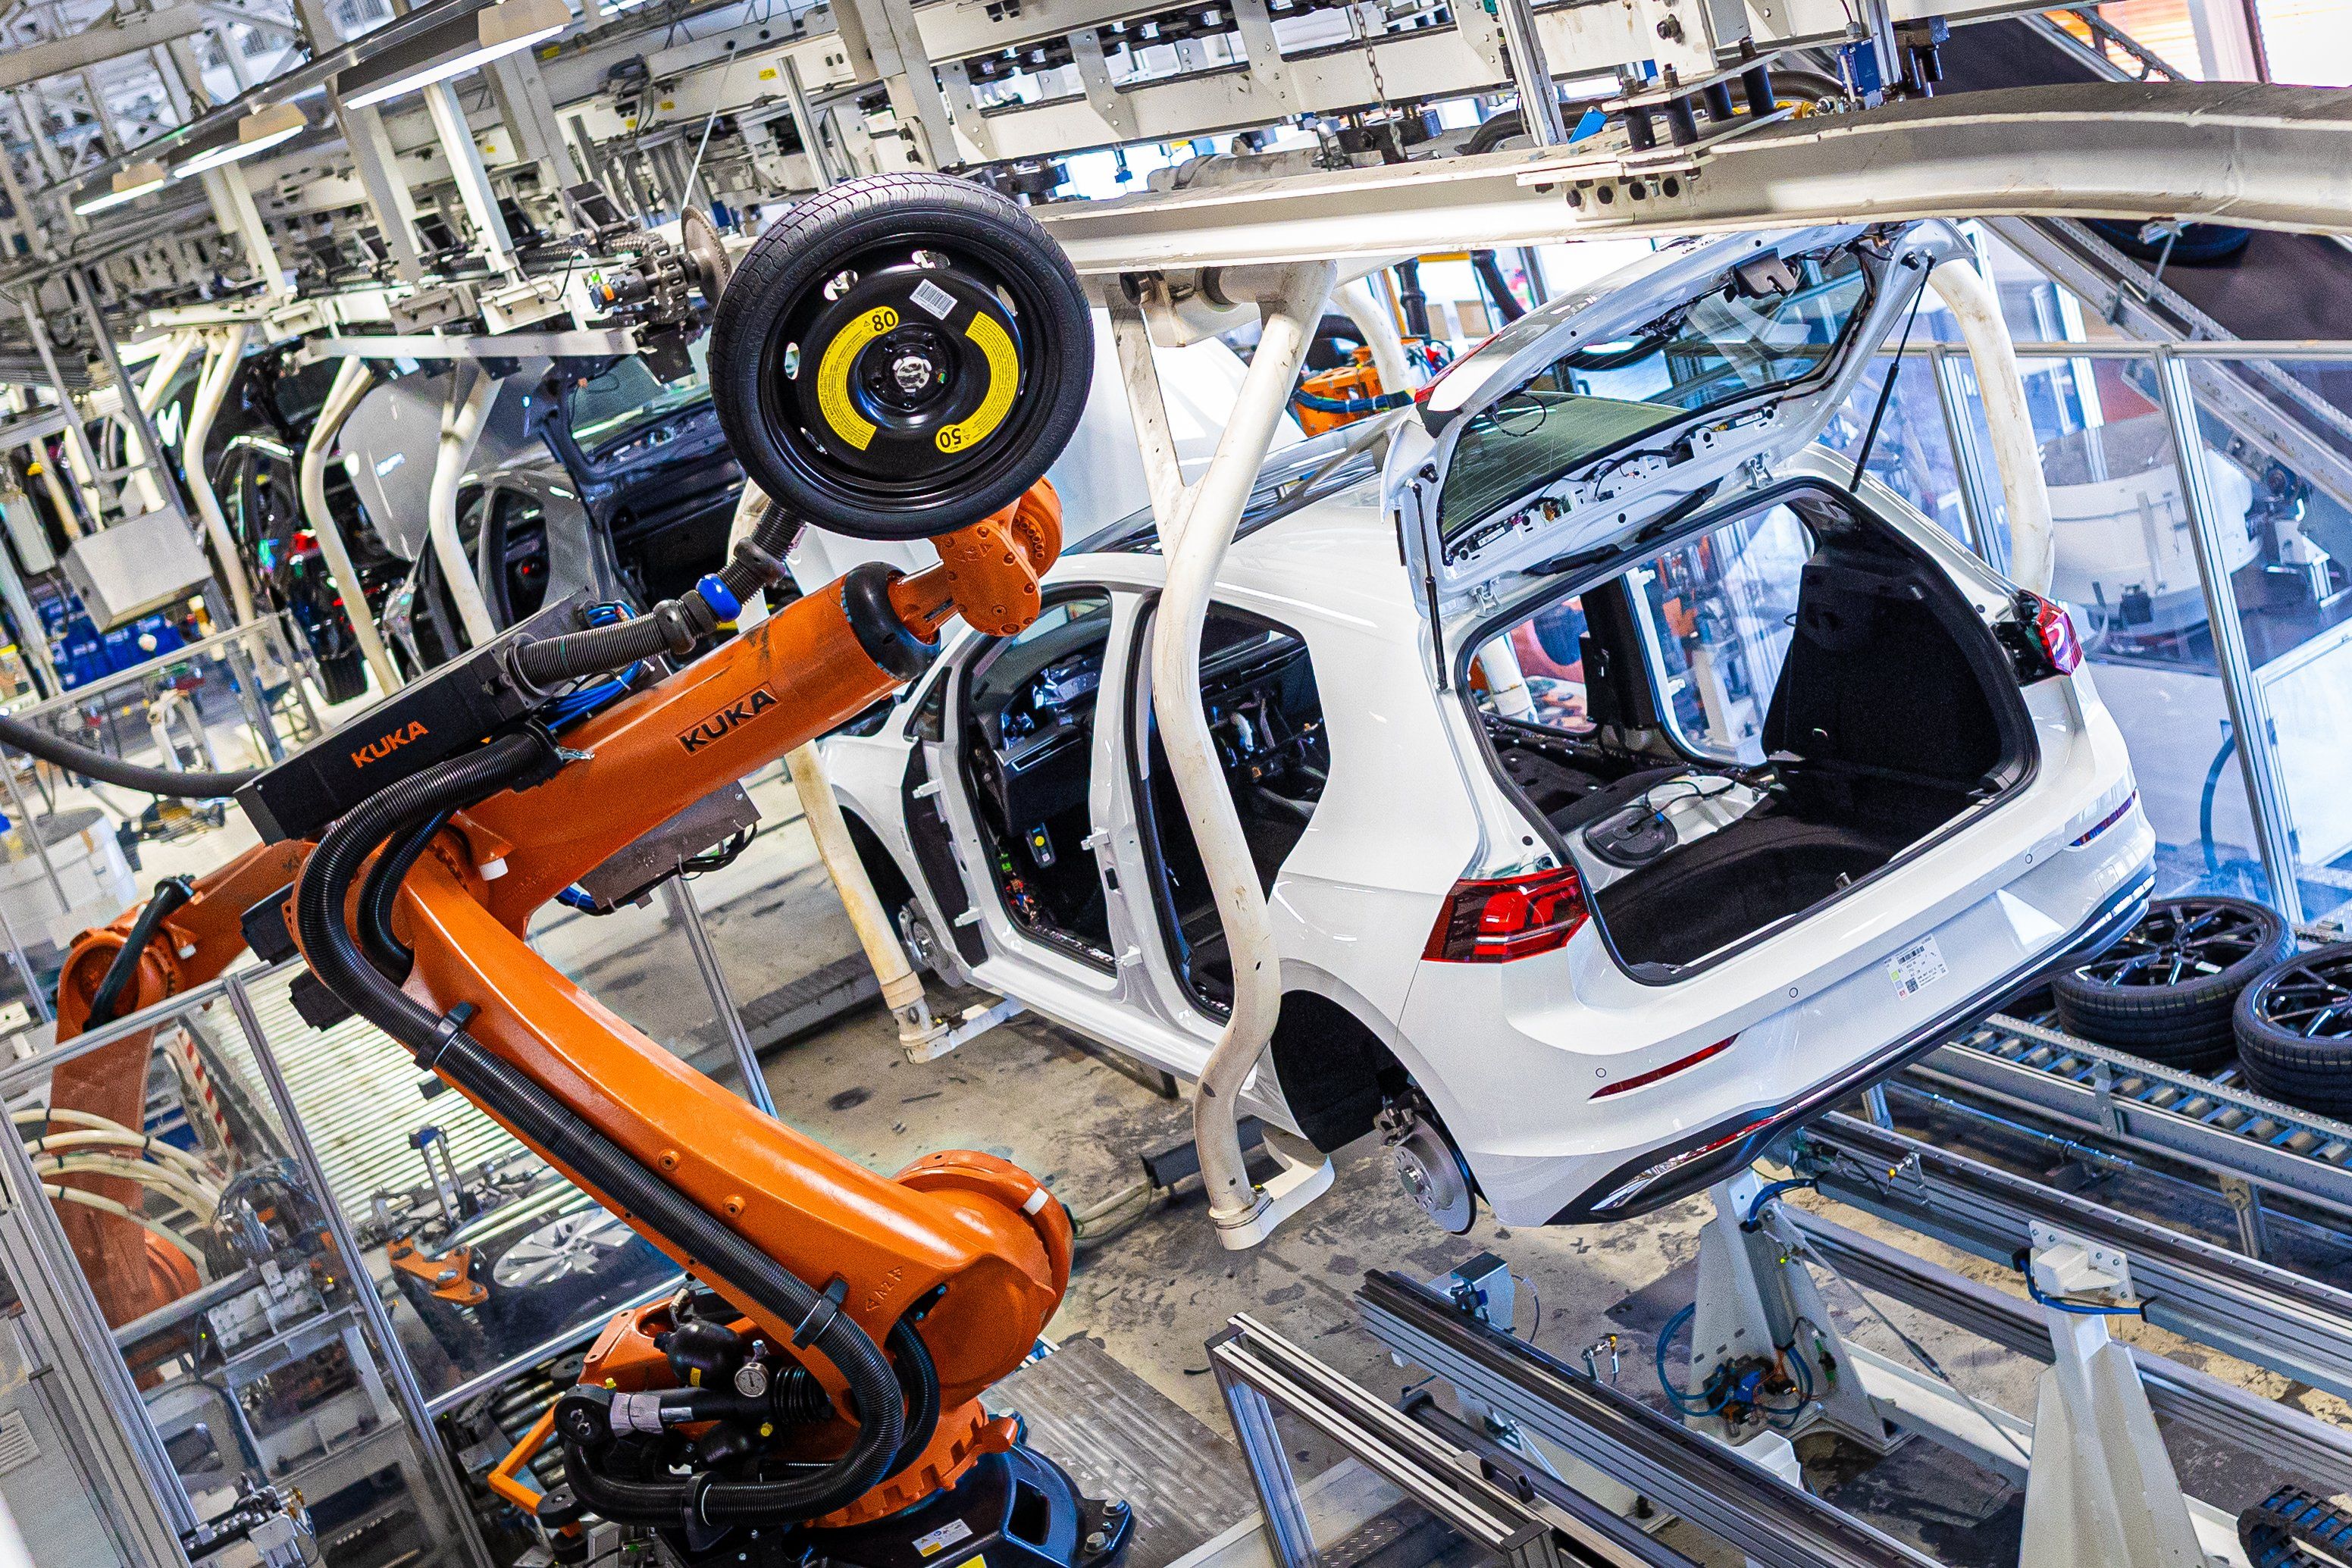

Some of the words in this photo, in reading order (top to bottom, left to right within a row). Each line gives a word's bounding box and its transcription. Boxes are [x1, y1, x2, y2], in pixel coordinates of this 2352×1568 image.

[872, 311, 896, 331] 80
[939, 428, 962, 448] 50
[681, 688, 777, 753] KUKA
[351, 720, 429, 768] KUKA
